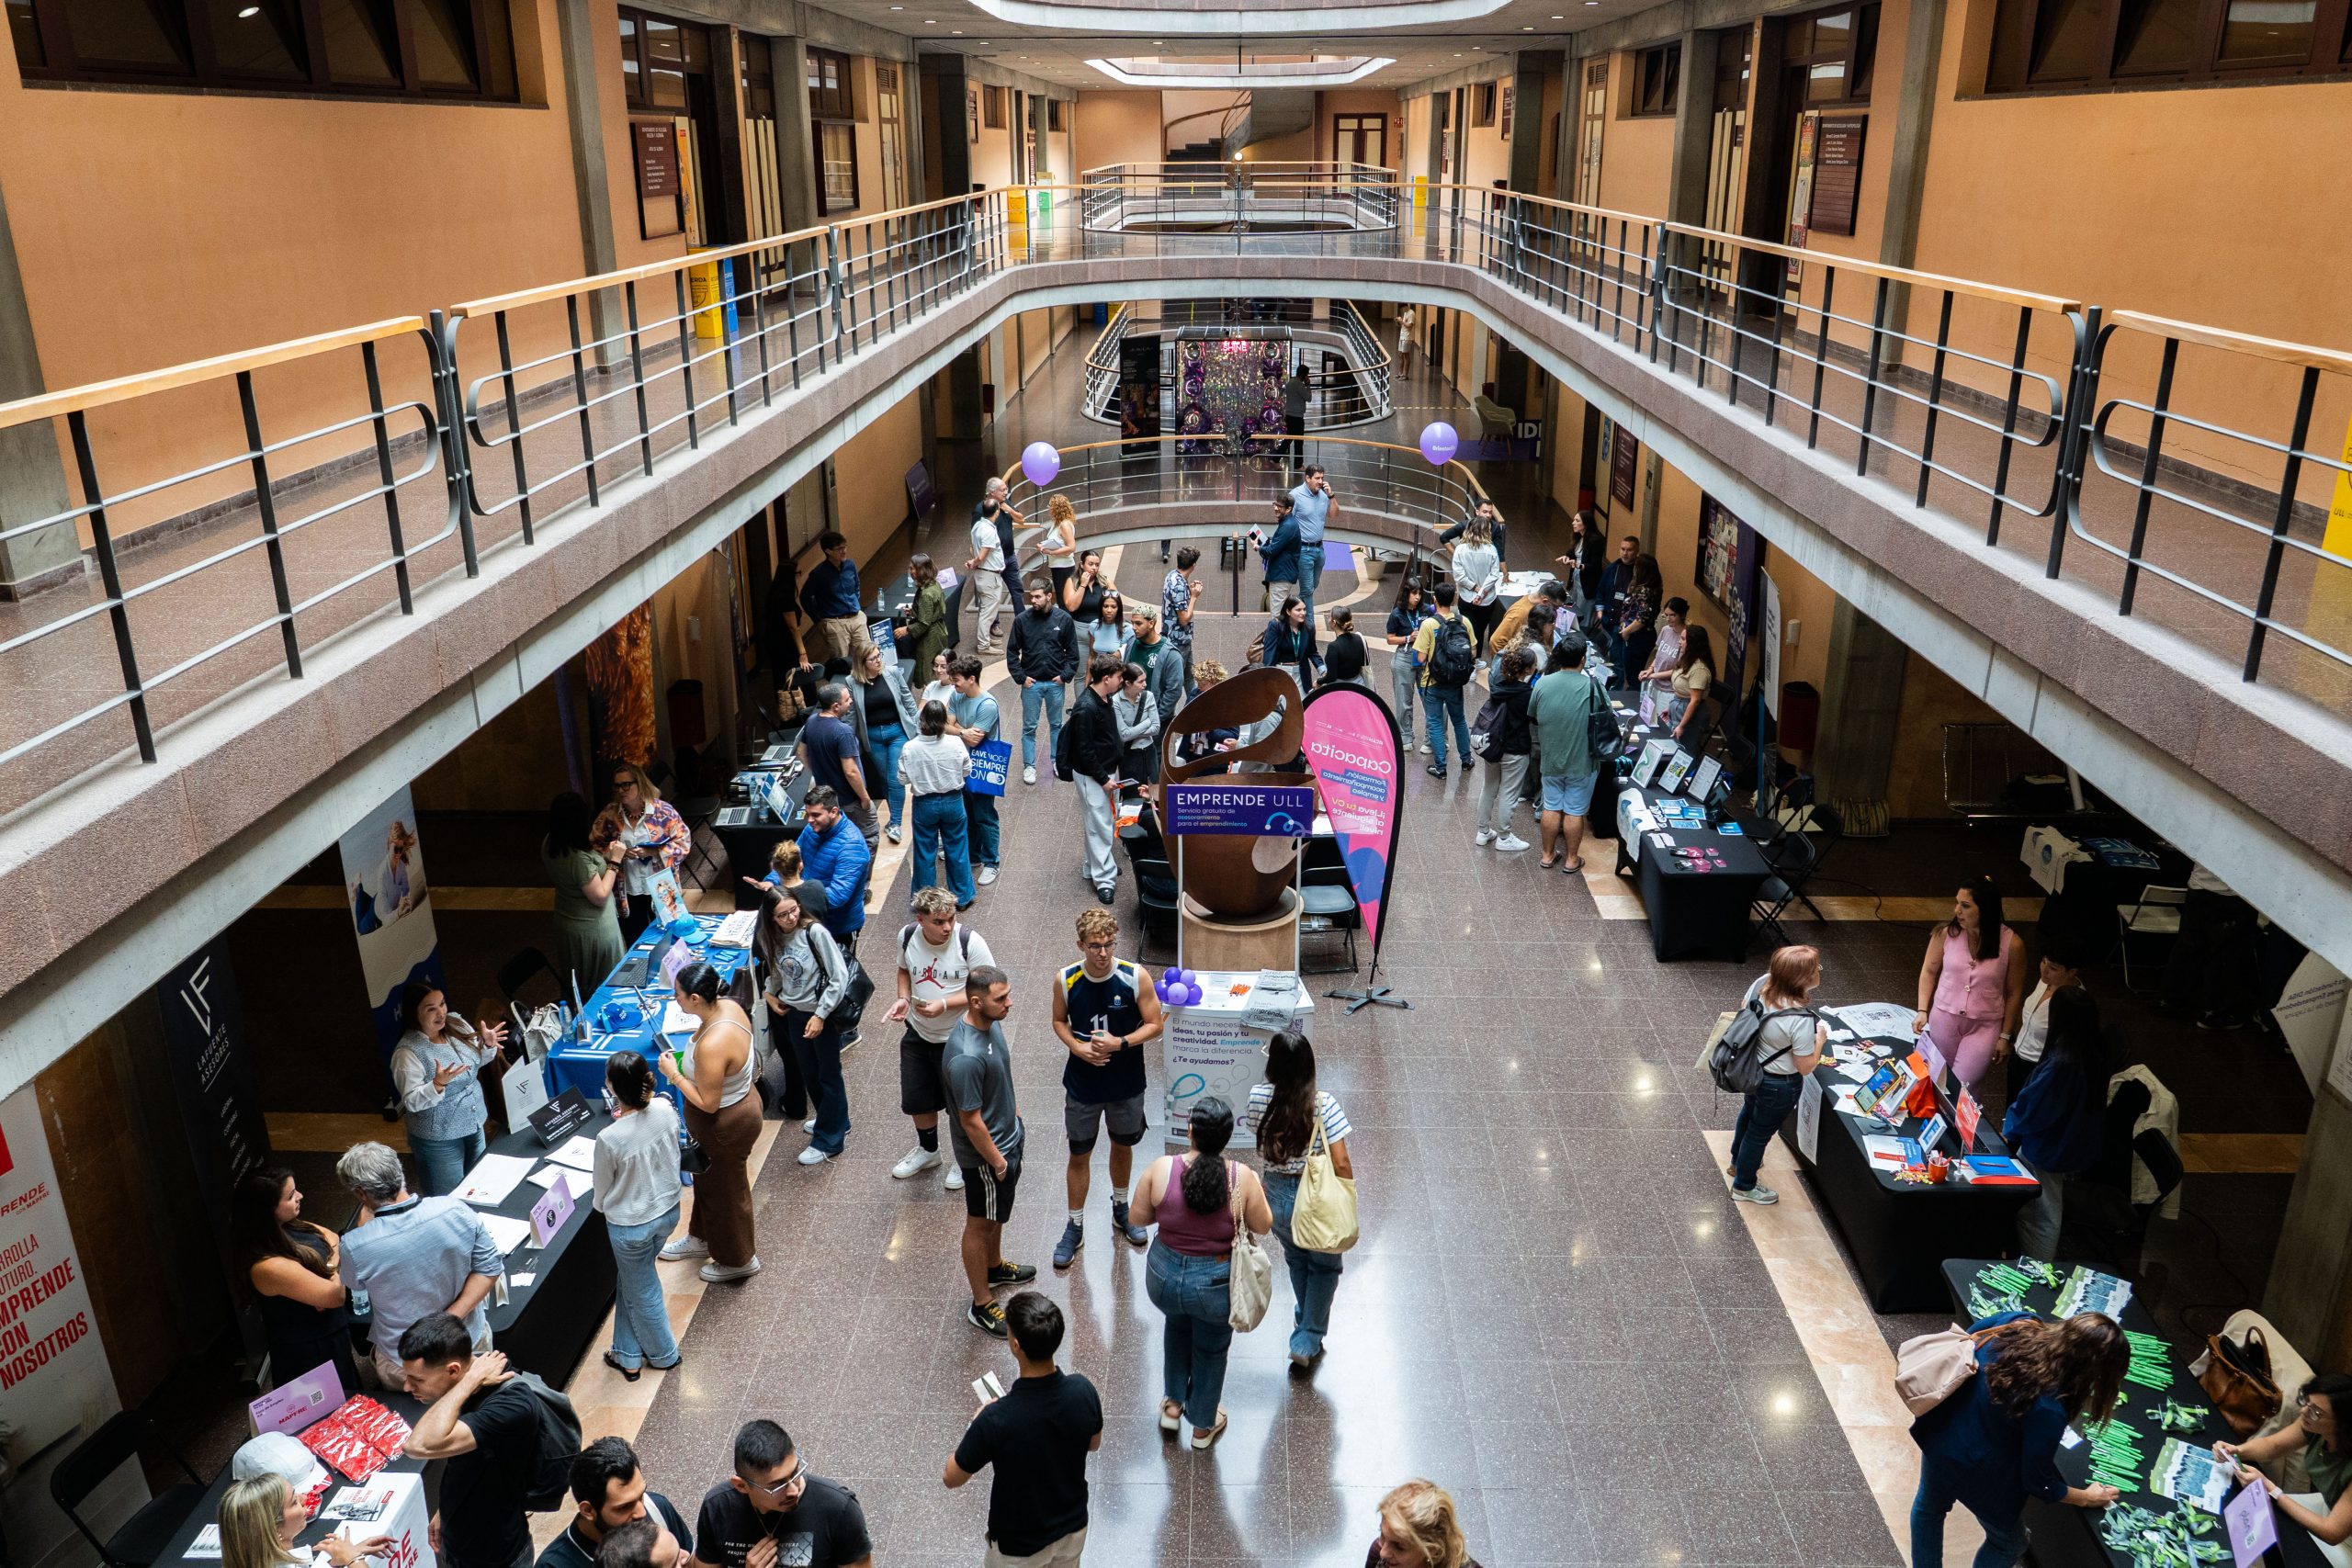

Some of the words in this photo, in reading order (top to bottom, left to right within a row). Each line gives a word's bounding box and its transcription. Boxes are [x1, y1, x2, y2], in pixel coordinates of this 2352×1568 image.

[1223, 343, 1248, 352] SHINE
[970, 758, 1007, 774] SIEMPRE
[969, 768, 987, 781] ON
[1177, 793, 1266, 807] EMPRENDE
[1273, 794, 1304, 807] ULL
[1202, 807, 1227, 816] gratuito
[1090, 1014, 1109, 1032] 11
[1182, 1019, 1211, 1028] mundo
[1172, 1027, 1196, 1036] ideas,
[1206, 1029, 1233, 1040] pasión
[196, 1022, 227, 1071] LAFUENTE
[1172, 1036, 1219, 1045] creatividad.
[1220, 1039, 1261, 1047] Emprende
[1172, 1044, 1200, 1054] marca
[1201, 1045, 1209, 1054] la
[200, 1037, 230, 1085] ASESORES
[1172, 1055, 1188, 1064] ¿Te
[1189, 1057, 1235, 1066] ayudamos?
[0, 1311, 88, 1392] NOSOTROS
[278, 1405, 308, 1426] MAPFRE
